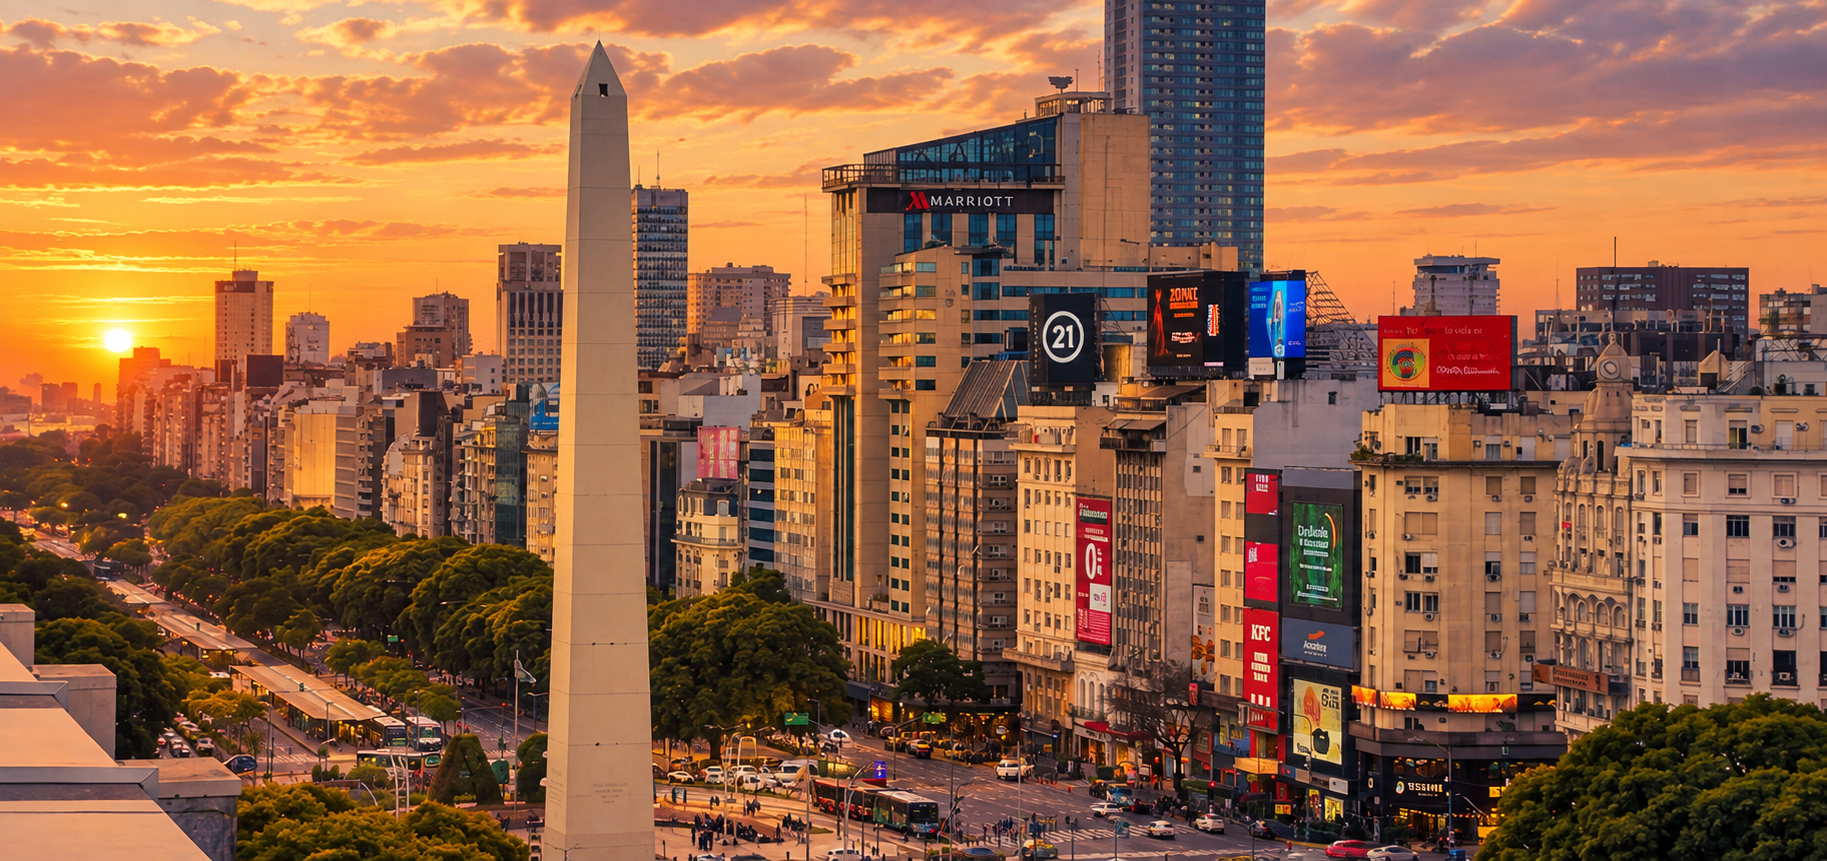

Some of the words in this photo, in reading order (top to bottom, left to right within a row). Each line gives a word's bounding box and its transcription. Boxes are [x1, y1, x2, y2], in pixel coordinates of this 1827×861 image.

[930, 196, 1014, 207] MARRIOTT
[1052, 324, 1074, 349] 21
[1251, 624, 1270, 642] KFC
